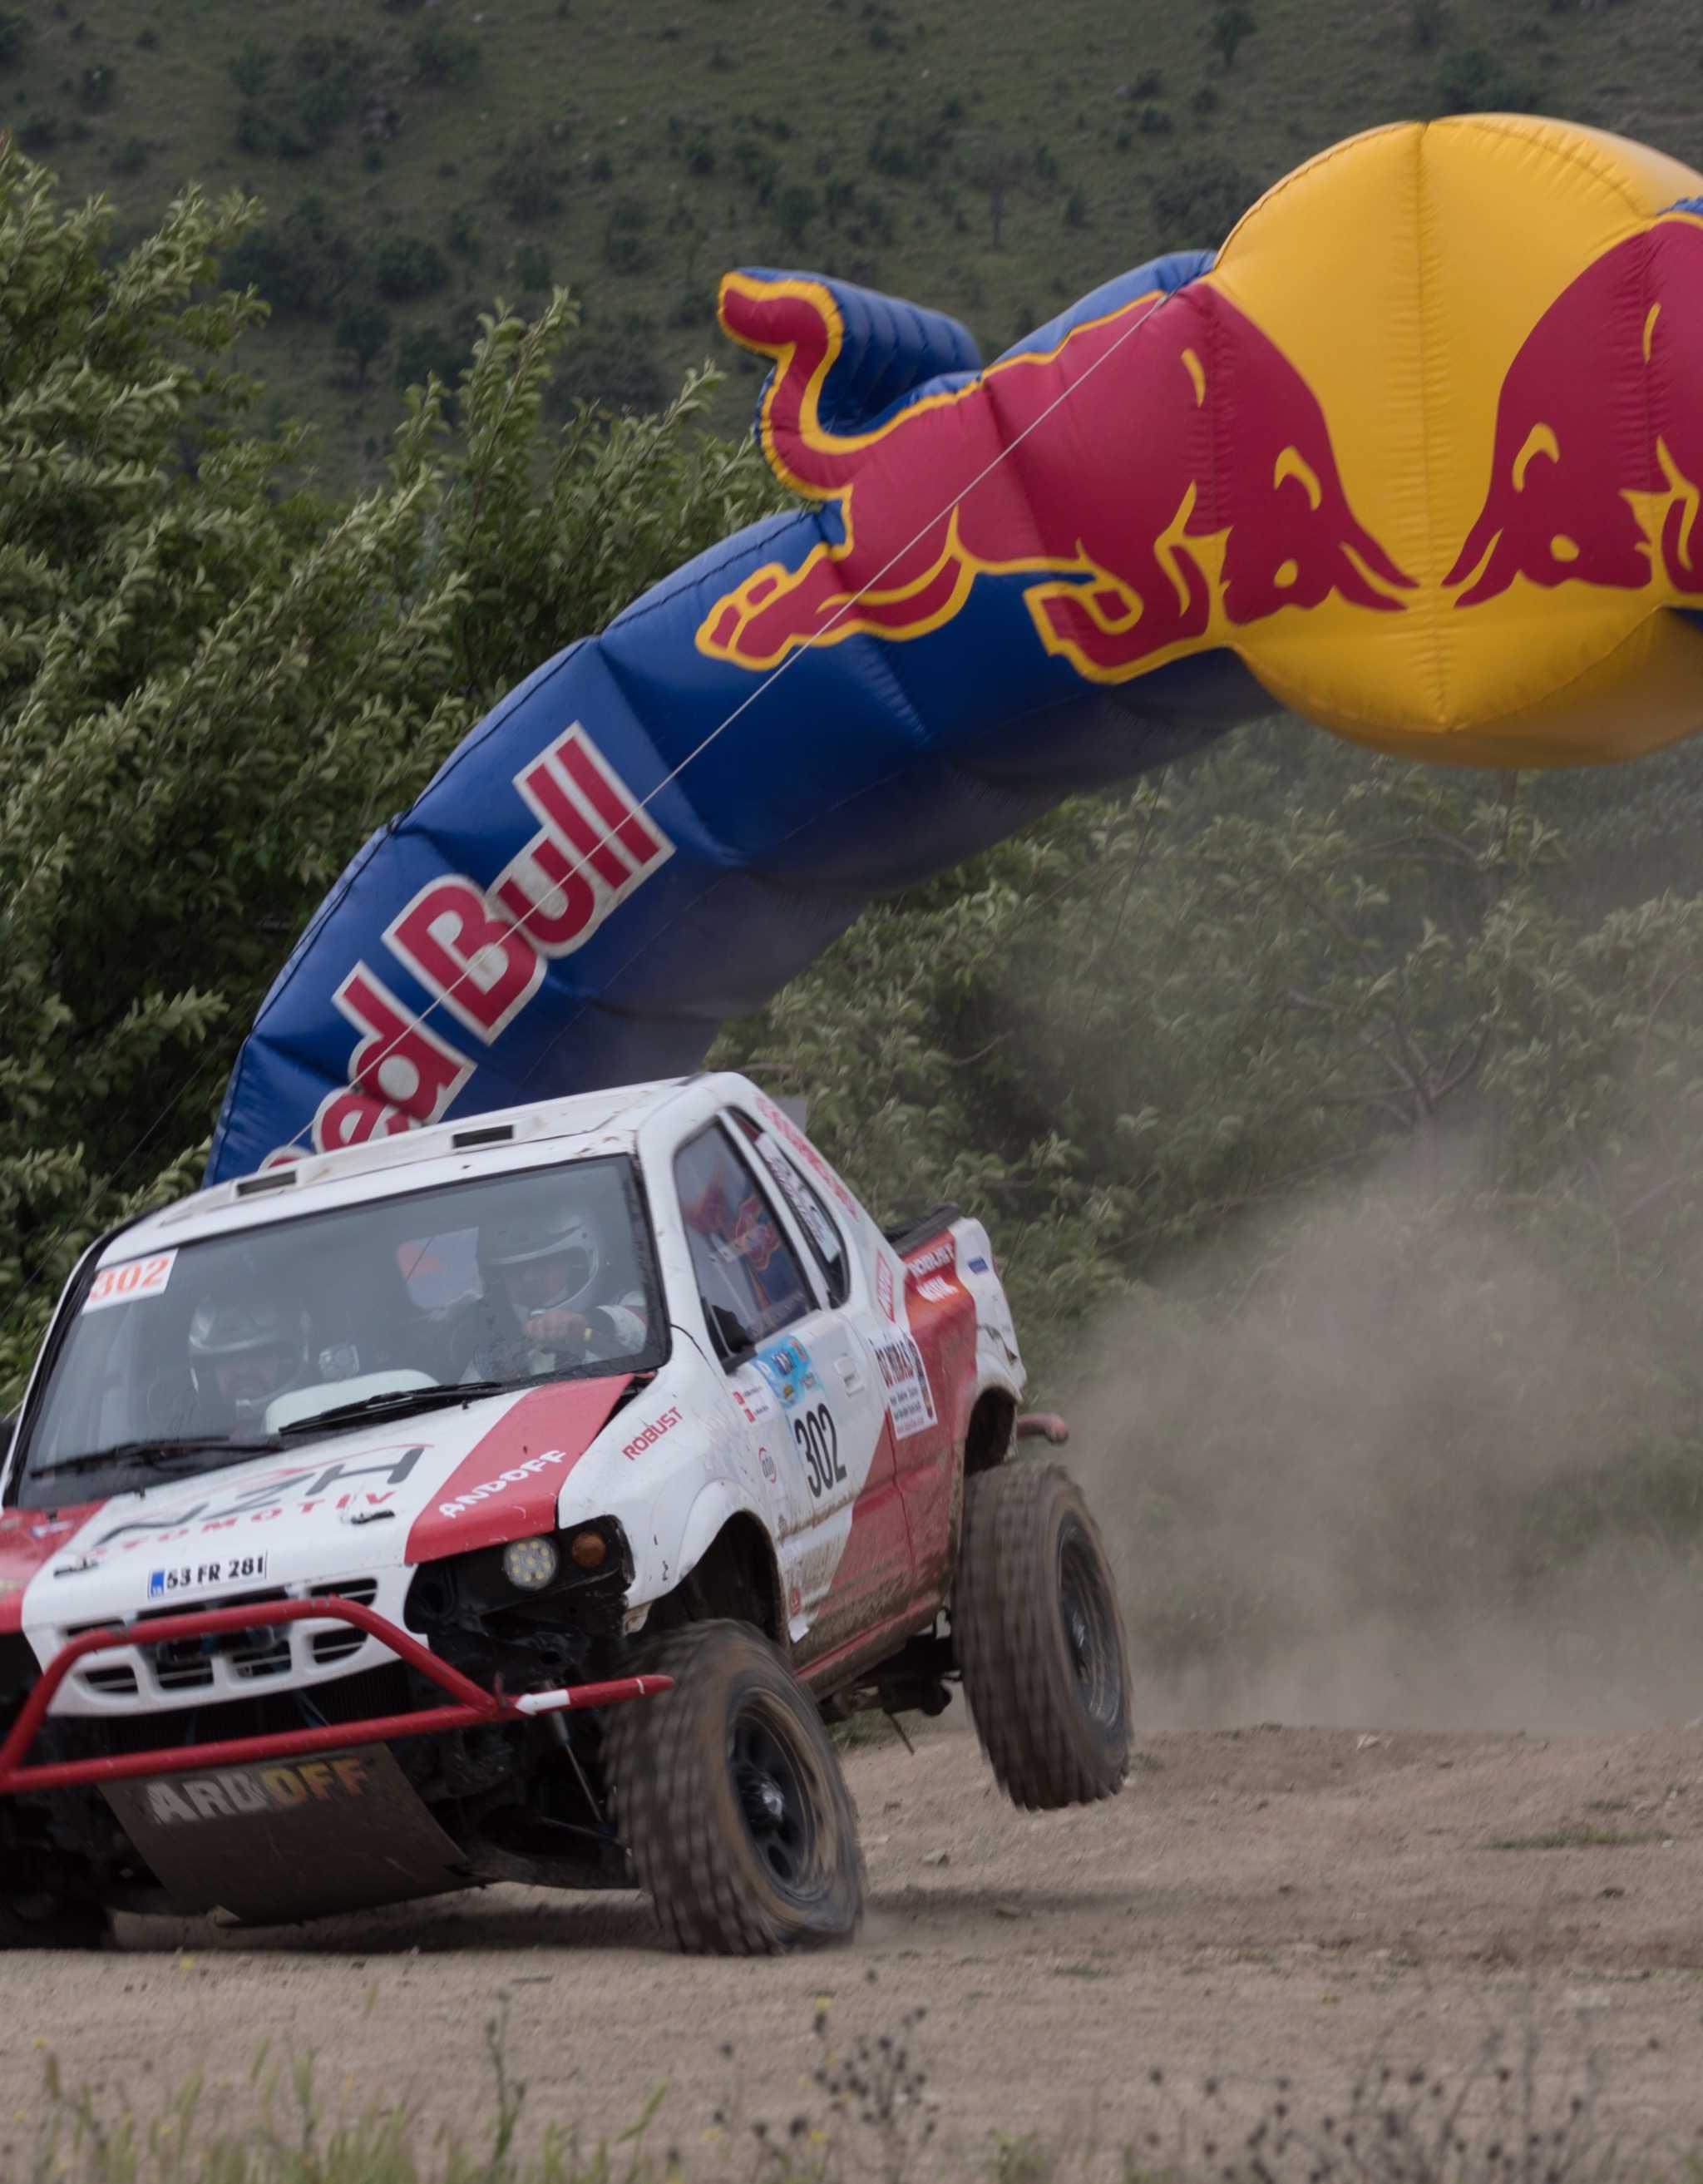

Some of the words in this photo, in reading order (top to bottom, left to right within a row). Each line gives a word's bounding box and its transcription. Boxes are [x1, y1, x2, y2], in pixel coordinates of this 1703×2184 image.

[259, 960, 477, 1171] ed
[382, 720, 676, 1045] Bull
[89, 1257, 170, 1302] 302
[622, 1406, 684, 1461] ROBUST
[794, 1402, 847, 1498] 302
[228, 1555, 264, 1579] 281
